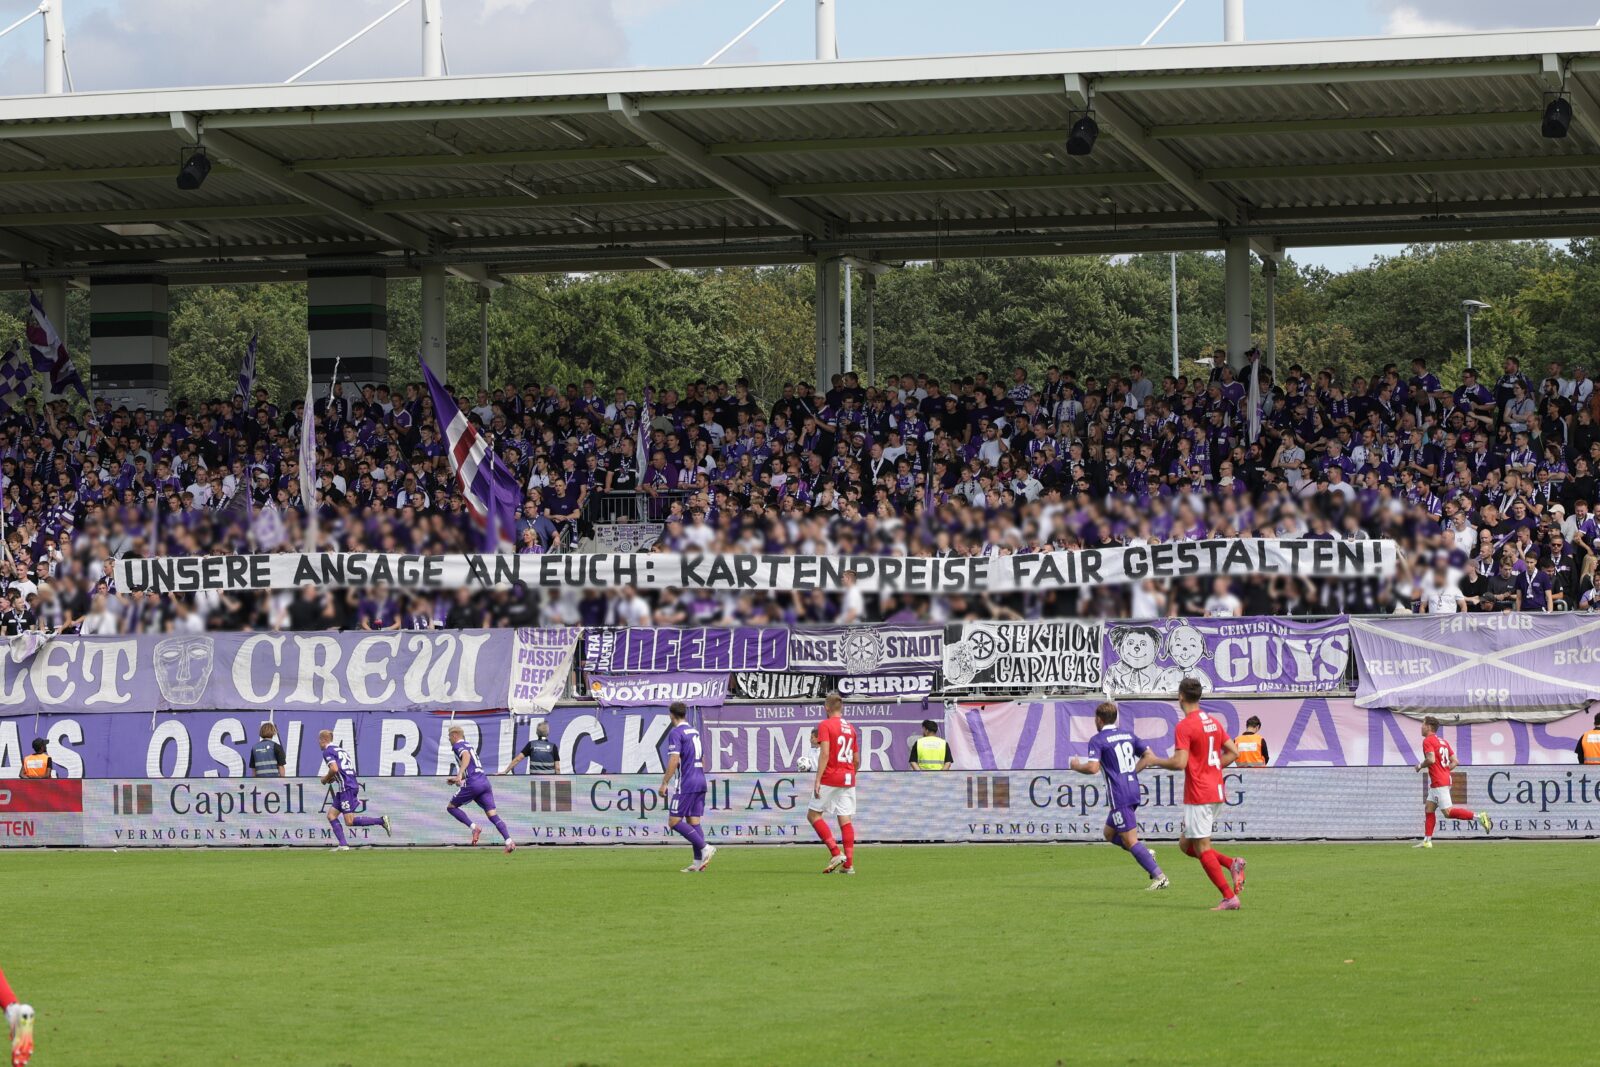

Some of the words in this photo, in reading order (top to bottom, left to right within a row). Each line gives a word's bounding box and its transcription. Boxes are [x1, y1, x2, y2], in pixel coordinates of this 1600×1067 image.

[125, 555, 270, 591] UNSERE
[293, 553, 444, 586] ANSAGE
[466, 554, 520, 585] AN
[540, 554, 654, 586] EUCH:
[680, 554, 989, 591] KARTENPREISE
[1012, 550, 1103, 586] FAIR
[1123, 539, 1382, 579] GESTALTEN!
[517, 627, 580, 646] ULTRAS
[1220, 622, 1289, 636] CERVISIAM
[1440, 614, 1533, 634] FAN-CLUB
[791, 638, 838, 662] HASE
[886, 635, 942, 659] STADT
[996, 624, 1100, 653] SEKTION
[995, 655, 1100, 684] CARACAS
[1214, 633, 1349, 683] GUYS
[513, 684, 543, 700] FAS
[601, 682, 703, 701] VOXTRUP
[838, 675, 933, 694] GEHRDE
[1467, 688, 1509, 703] 1989
[755, 707, 795, 719] EIMER
[804, 705, 826, 717] IST
[840, 704, 892, 716] EINMAL
[708, 726, 894, 773] EIMR
[837, 736, 853, 764] 24
[1114, 742, 1136, 774] 18
[1208, 736, 1221, 770] 4
[170, 783, 306, 822] Capitell
[590, 779, 732, 819] Capll
[745, 778, 799, 811] AG
[1029, 774, 1177, 816] Capiell
[1222, 774, 1246, 807] G
[115, 827, 371, 840] VERMÖGENS-MANAGEMNT
[532, 824, 799, 837] VERMÖGENS-MAGEMENT
[1439, 818, 1594, 832] ERMGENS-MA
